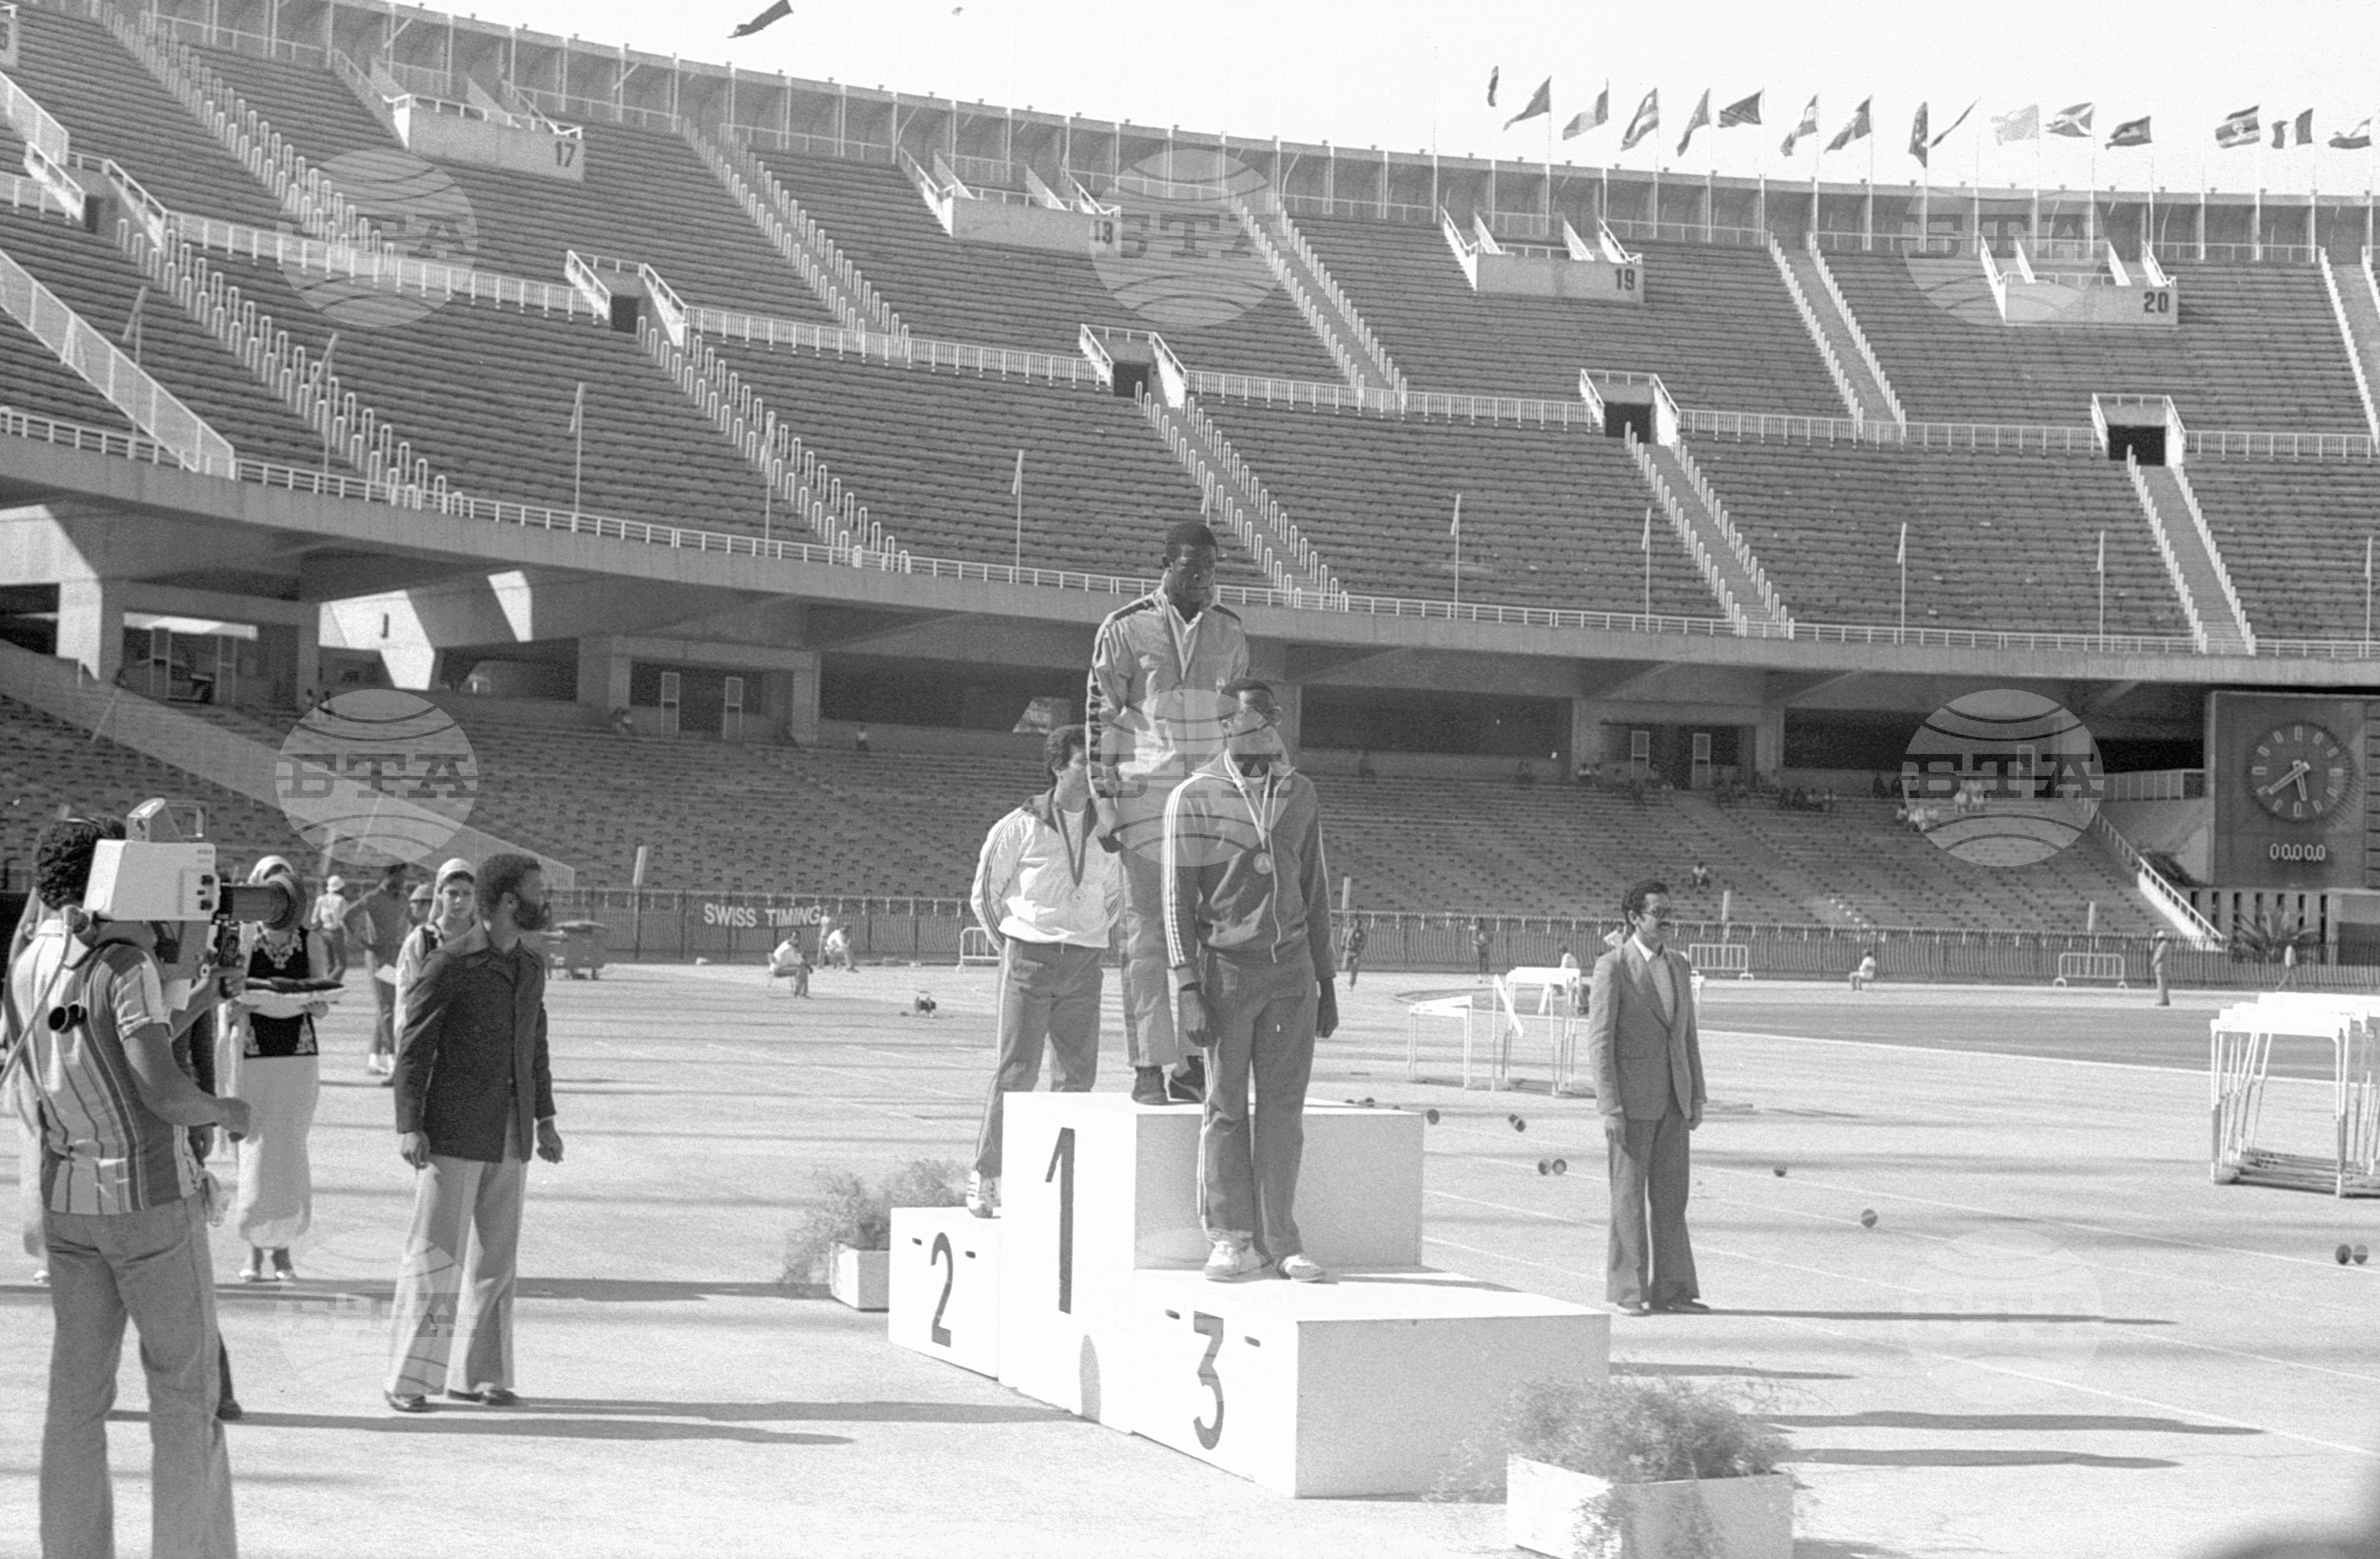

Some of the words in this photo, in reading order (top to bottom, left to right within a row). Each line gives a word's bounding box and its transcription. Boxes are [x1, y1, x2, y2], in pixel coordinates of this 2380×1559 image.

[555, 140, 577, 168] 17
[1093, 220, 1114, 245] 18
[1615, 268, 1636, 291] 19
[2144, 290, 2169, 313] 20
[704, 903, 757, 928] SWISS
[765, 905, 821, 927] TIMING
[1045, 1126, 1075, 1314] 1
[931, 1232, 953, 1348] 2
[1193, 1310, 1225, 1451] 3
